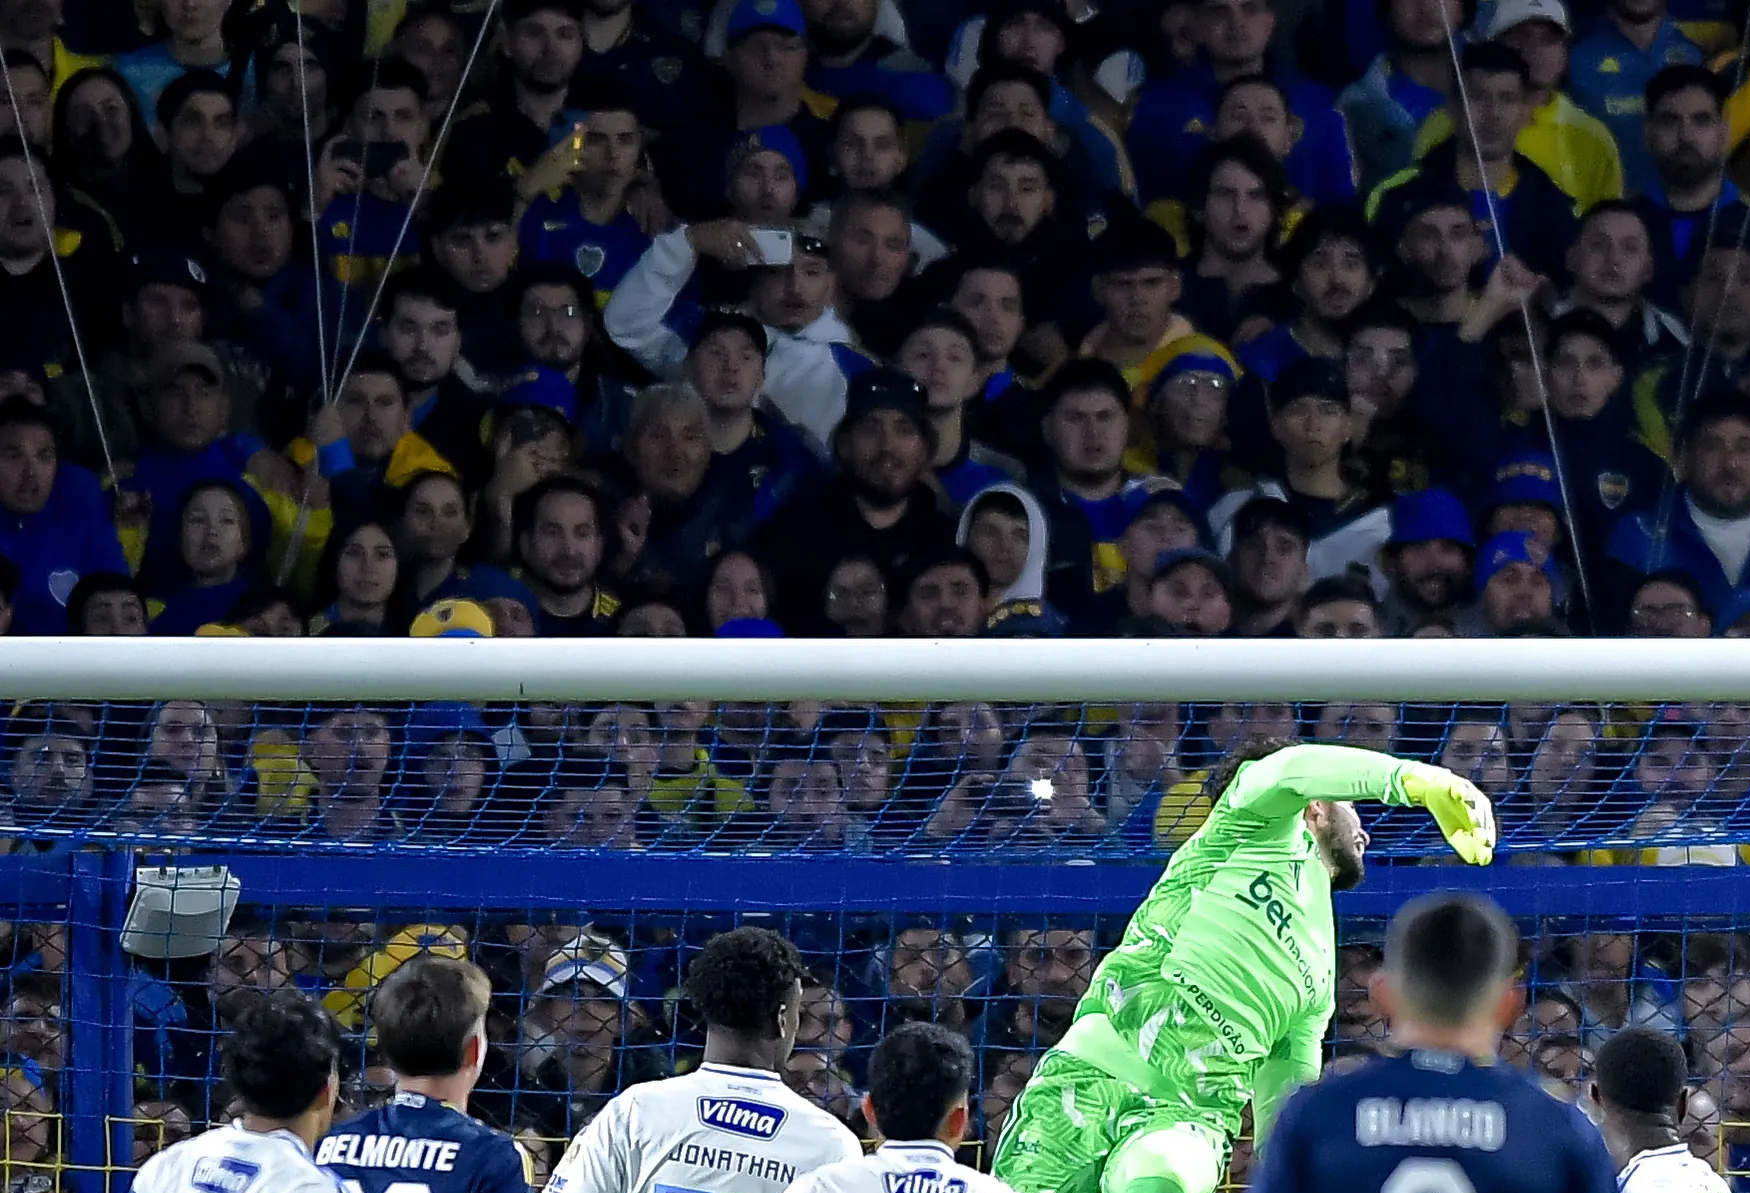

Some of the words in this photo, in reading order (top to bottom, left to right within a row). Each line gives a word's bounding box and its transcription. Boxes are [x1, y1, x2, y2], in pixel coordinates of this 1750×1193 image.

[1187, 984, 1246, 1055] PERDIGÃO
[702, 1100, 776, 1134] Vilma
[1355, 1096, 1507, 1152] BLANCO
[316, 1134, 461, 1172] BELMONTE
[670, 1143, 796, 1184] JONATHAN
